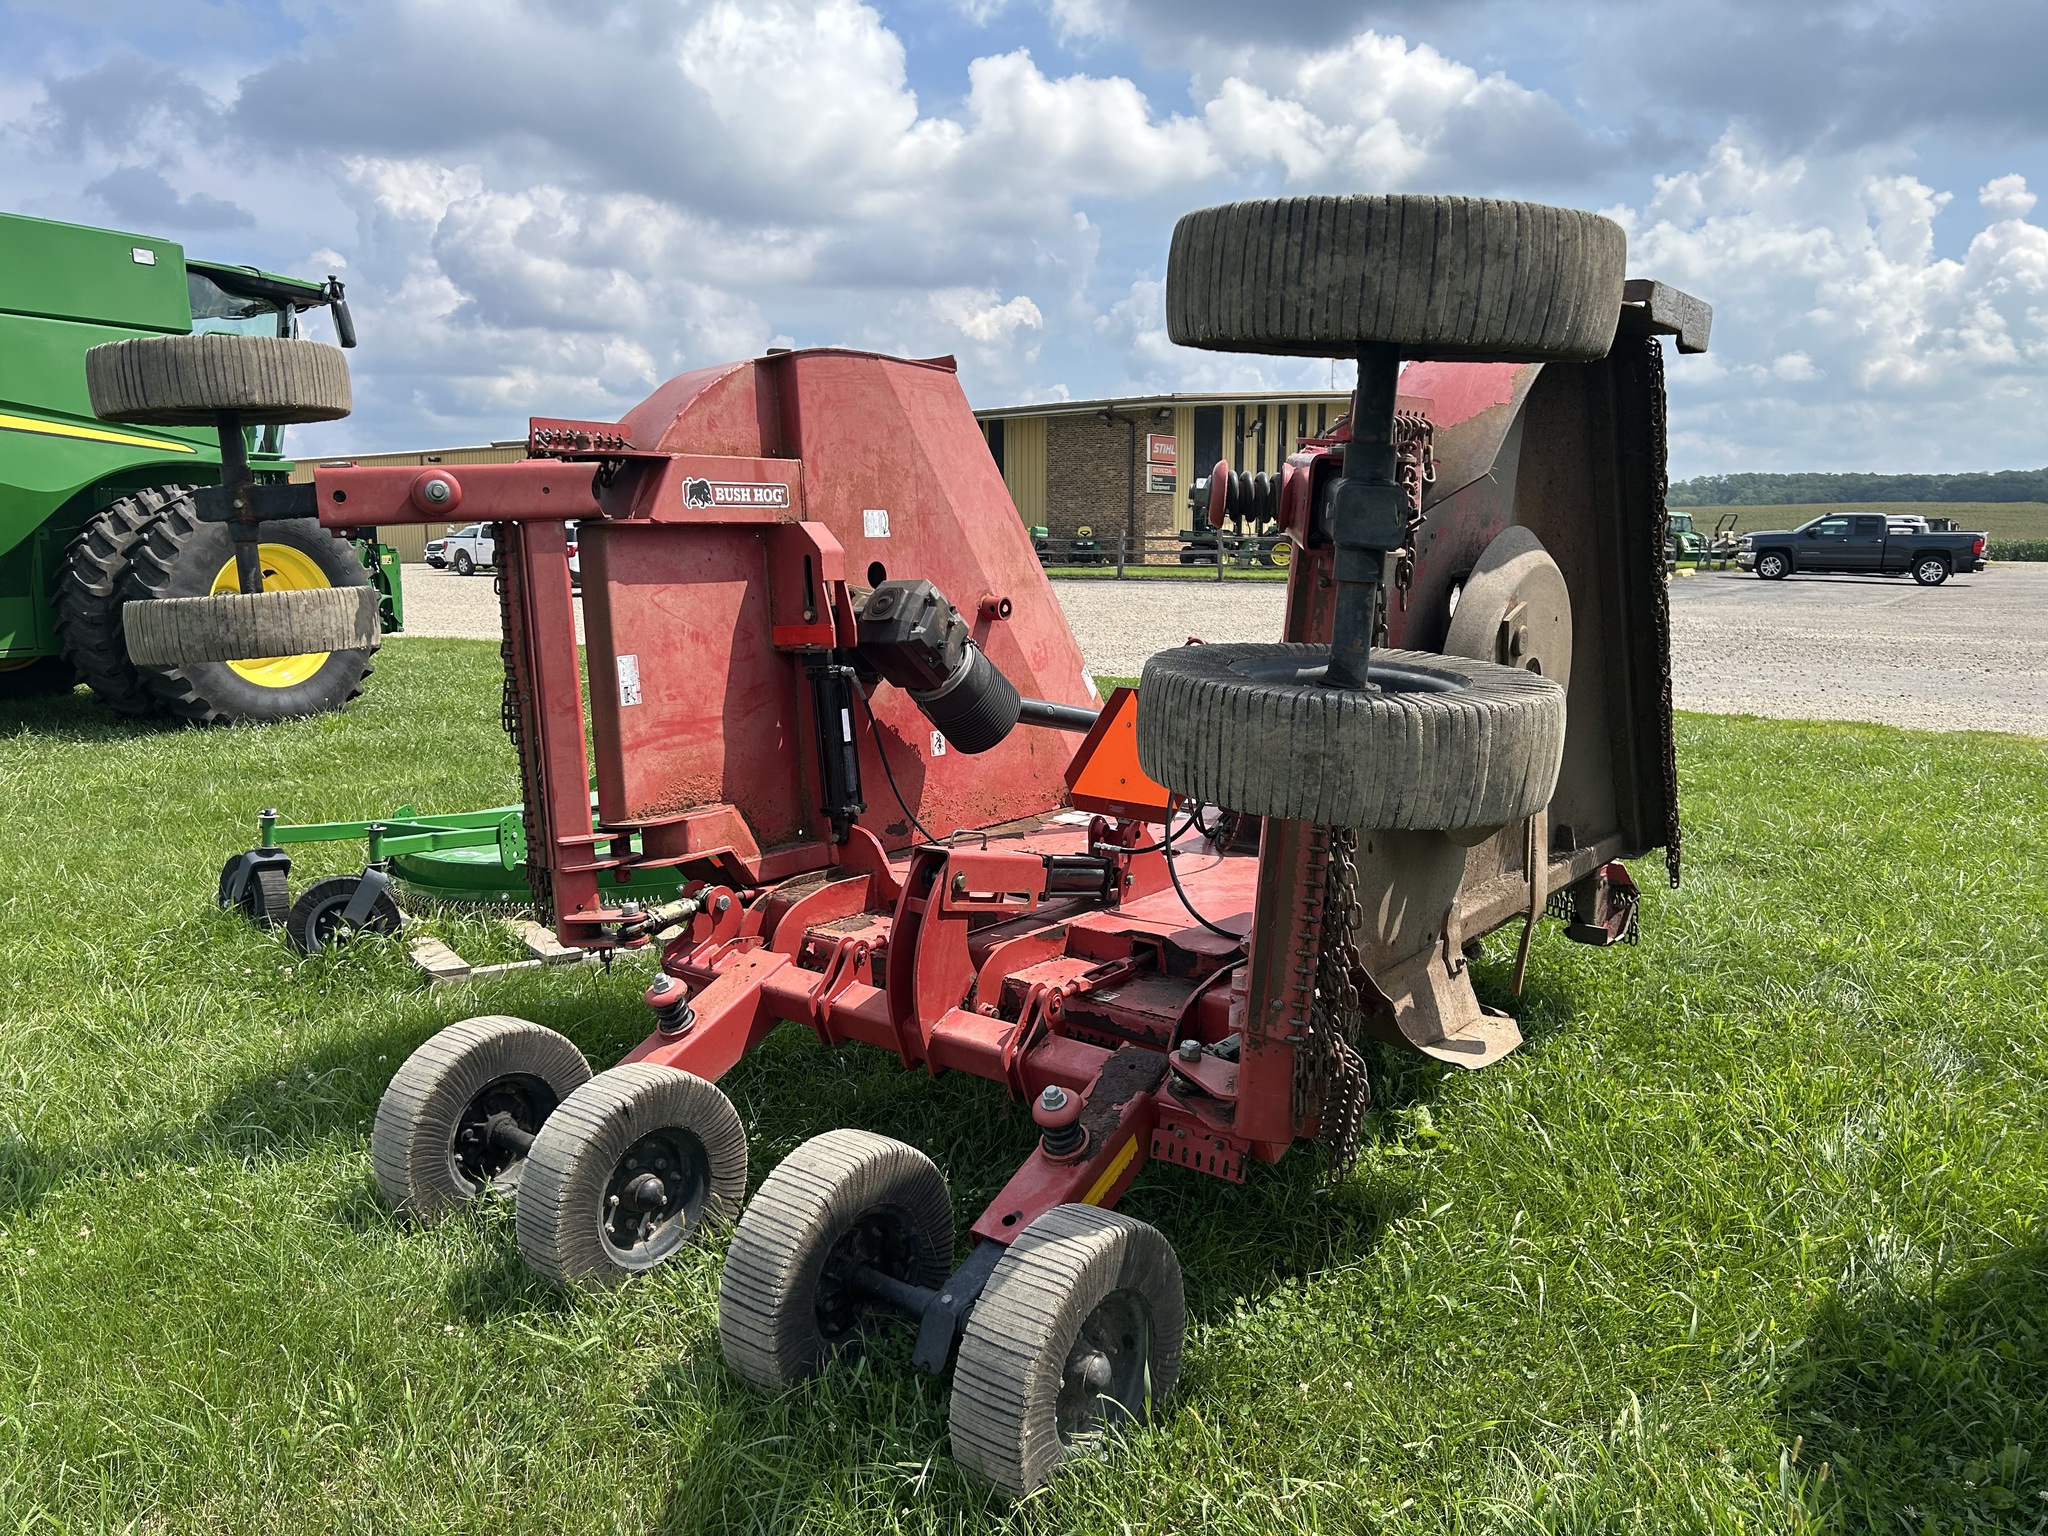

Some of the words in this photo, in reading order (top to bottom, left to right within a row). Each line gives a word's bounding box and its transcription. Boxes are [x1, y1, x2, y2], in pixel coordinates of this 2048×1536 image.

[1153, 443, 1176, 455] STIHL
[1152, 467, 1173, 475] HONDA
[715, 487, 751, 502] BUSH
[753, 488, 783, 502] HOG
